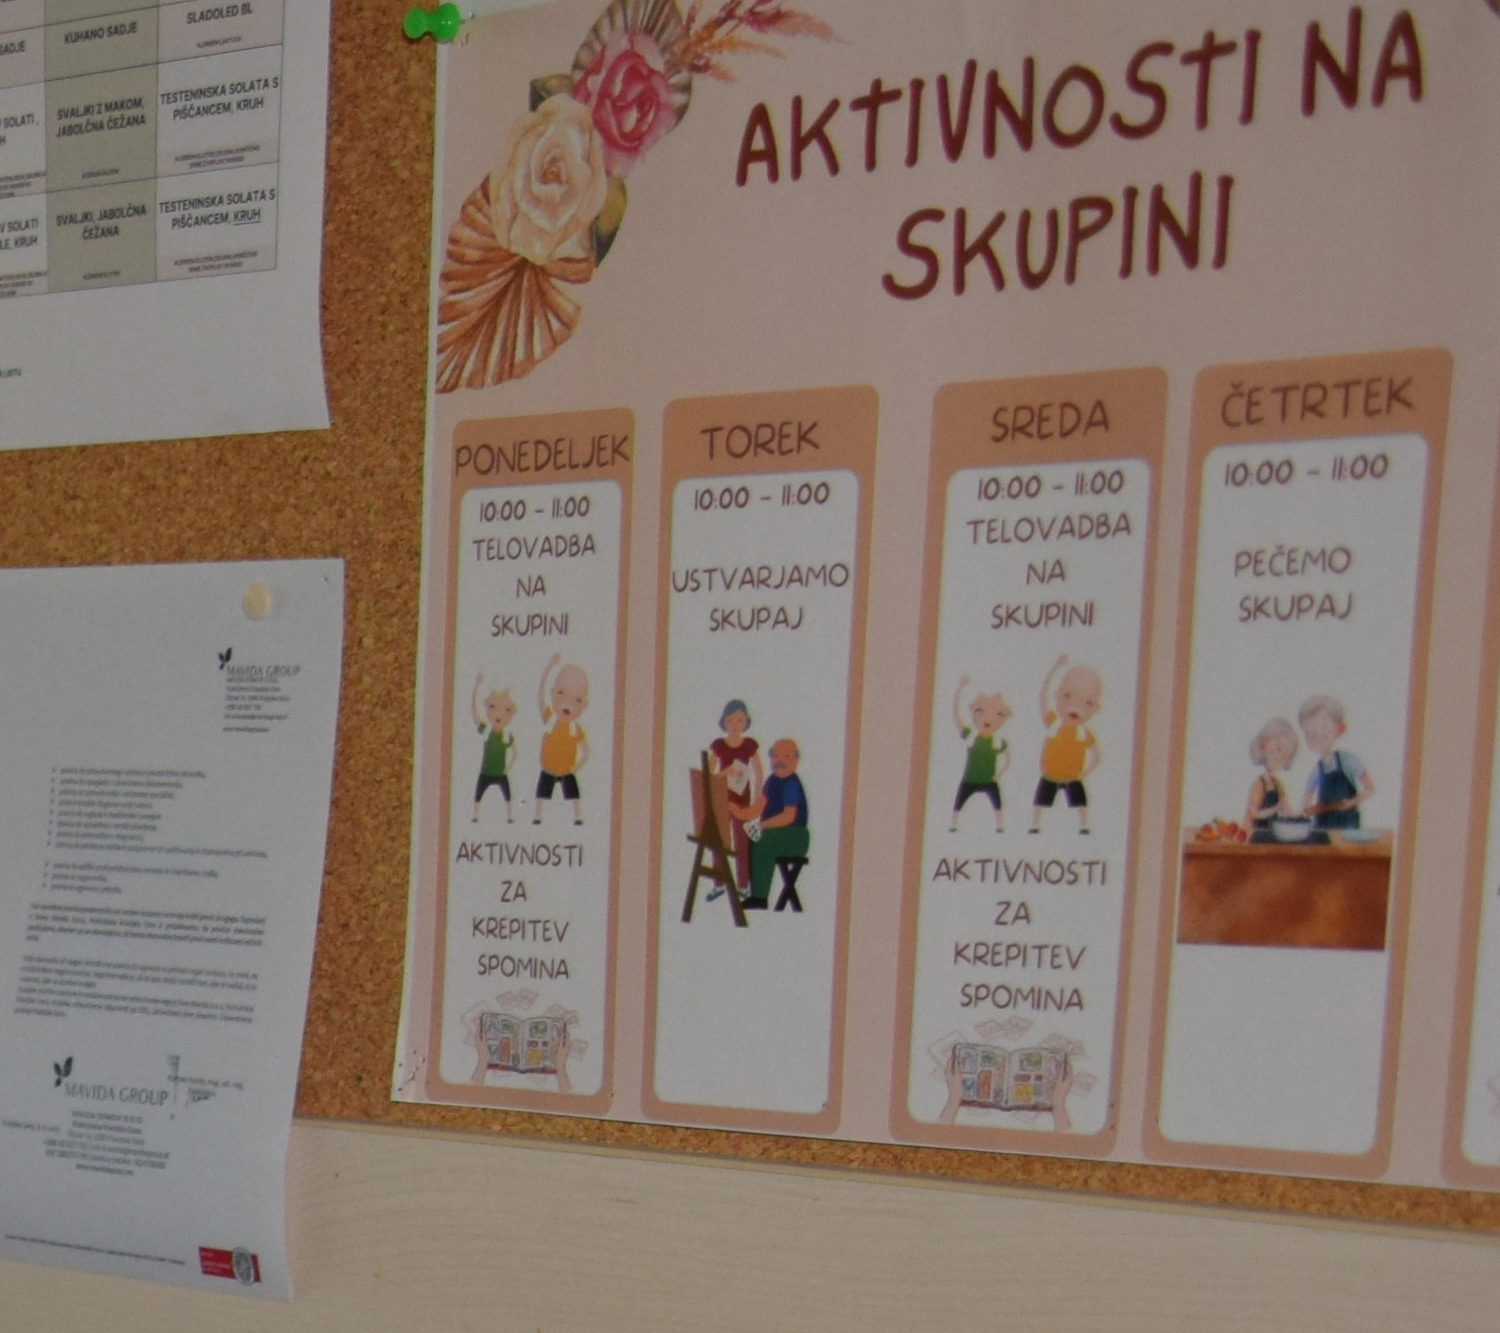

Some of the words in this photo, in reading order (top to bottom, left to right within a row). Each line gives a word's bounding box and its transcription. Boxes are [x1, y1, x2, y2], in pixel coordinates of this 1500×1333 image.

[186, 5, 239, 25] SLADOLED
[64, 27, 105, 44] KUHANO
[106, 22, 138, 37] SADJE
[160, 84, 226, 105] TESTENINSKA
[228, 78, 270, 96] SOLATA
[236, 97, 264, 112] KRUH
[735, 29, 1262, 187] AKTIVNOSTI
[1300, 5, 1424, 117] NA
[56, 118, 105, 138] JABOLČNA
[106, 113, 146, 131] ČEŽANA
[159, 195, 225, 214] TESTENINSKA
[226, 190, 267, 207] SOLATA
[7, 218, 38, 231] SOLATI
[233, 209, 261, 224] KRUH
[14, 236, 38, 248] KRUH
[82, 225, 119, 241] ČEŽANA
[881, 170, 1235, 301] SKUPINI
[1221, 377, 1415, 428] ČETRTEK
[991, 400, 1110, 444] SREDA
[701, 421, 820, 460] TOREK
[455, 434, 630, 477] PONEDELJEK
[1225, 459, 1294, 487] 10:00
[1332, 453, 1388, 480] 11:00
[695, 486, 750, 511] 10:00
[781, 483, 830, 505] 11:00
[978, 474, 1042, 501] 10:00
[1075, 470, 1125, 496] 11:00
[480, 499, 526, 522] 10:00
[552, 496, 590, 518] 11:00
[966, 512, 1132, 544] TELOVADBA
[472, 534, 596, 561] TELOVADBA
[1026, 559, 1066, 586] NA
[1234, 544, 1352, 578] PEČEMO
[516, 576, 547, 598] NA
[672, 563, 850, 592] USTVARJAMO
[708, 606, 804, 632] SKUPAJ
[991, 601, 1095, 629] SKUPINI
[1238, 592, 1354, 622] SKUPAJ
[491, 613, 569, 637] SKUPINI
[266, 664, 301, 678] GROUP
[456, 842, 583, 867] AKTIVNOSTI
[933, 858, 1107, 886] AKTIVNOSTI
[501, 880, 527, 903] ZA
[994, 901, 1031, 925] ZA
[472, 917, 569, 943] KREPITEV
[477, 954, 569, 980] SPOMINA
[954, 942, 1087, 970] KREPITEV
[960, 983, 1084, 1012] SPOMINA
[64, 1081, 115, 1102] MAVIDA
[119, 1087, 169, 1107] GROUP
